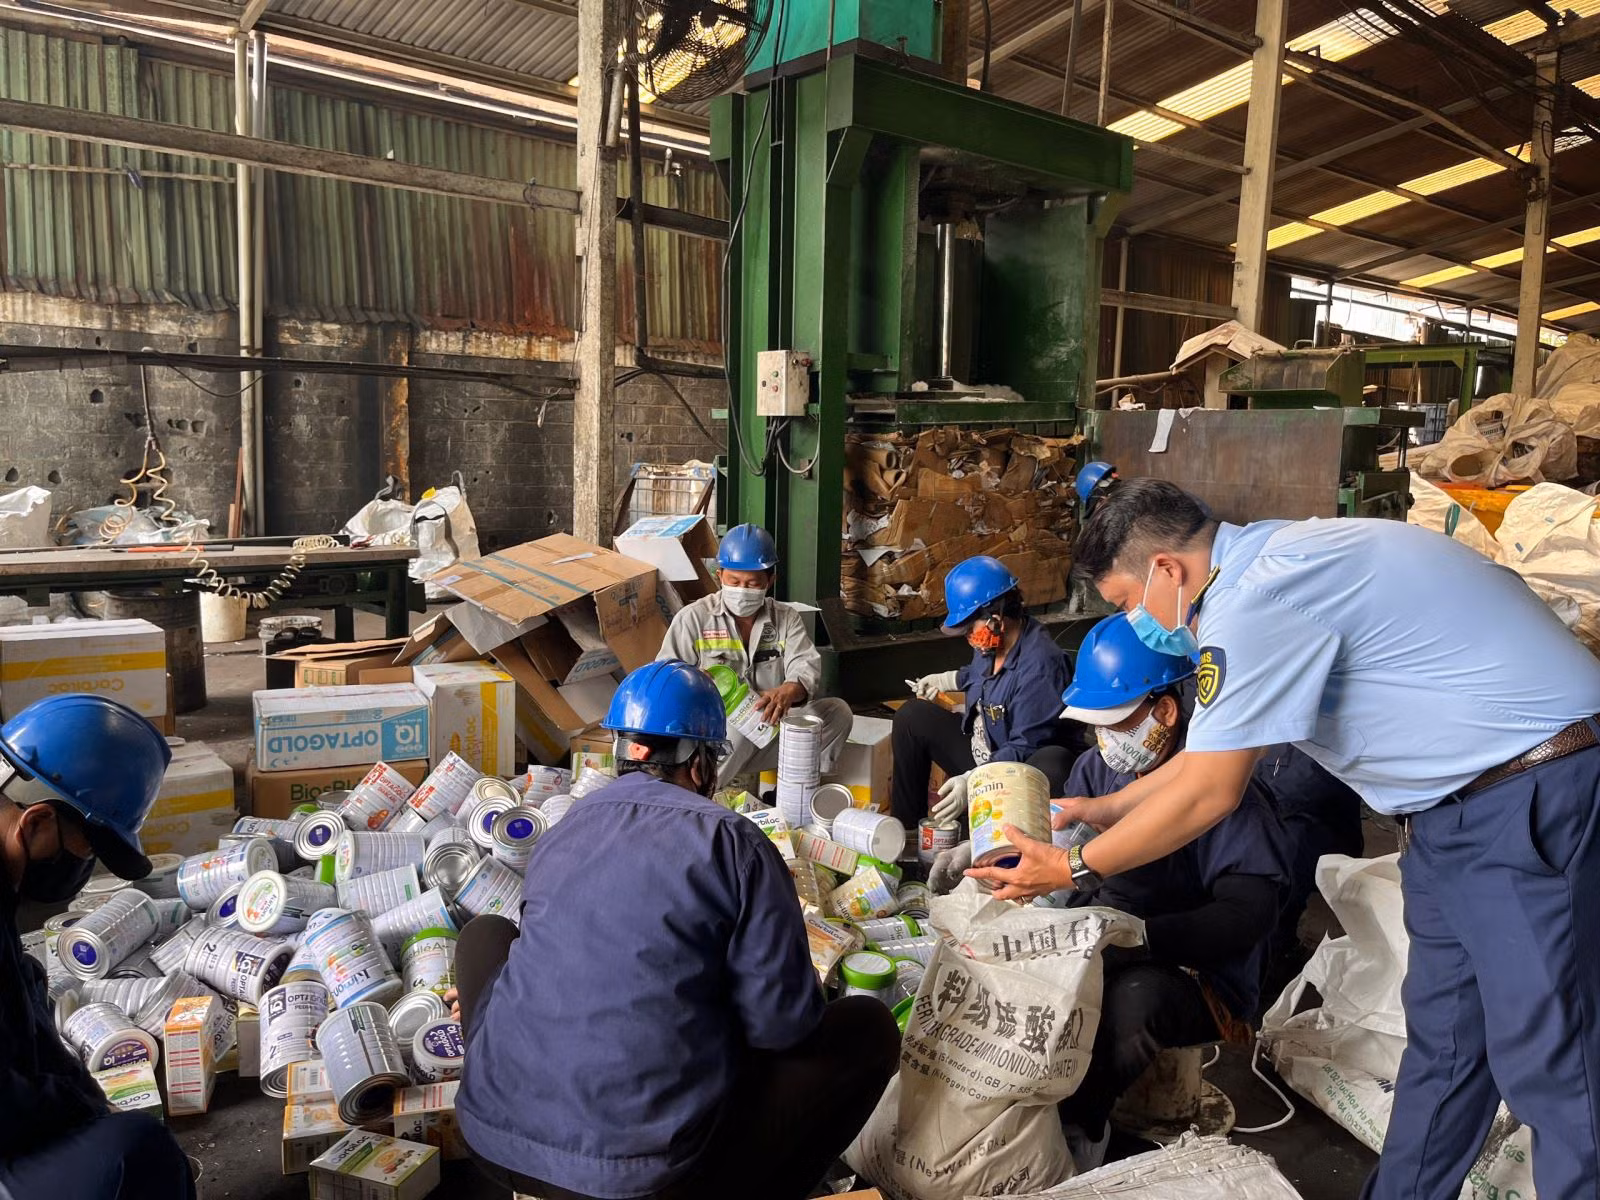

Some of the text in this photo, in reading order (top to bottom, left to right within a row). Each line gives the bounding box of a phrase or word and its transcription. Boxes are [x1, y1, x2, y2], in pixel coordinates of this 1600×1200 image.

[267, 730, 378, 753] OPTAGOLD
[437, 1029, 455, 1057] OPTAGOLD
[940, 1024, 980, 1053] GRADE
[972, 1041, 1041, 1080] AMMONIUM
